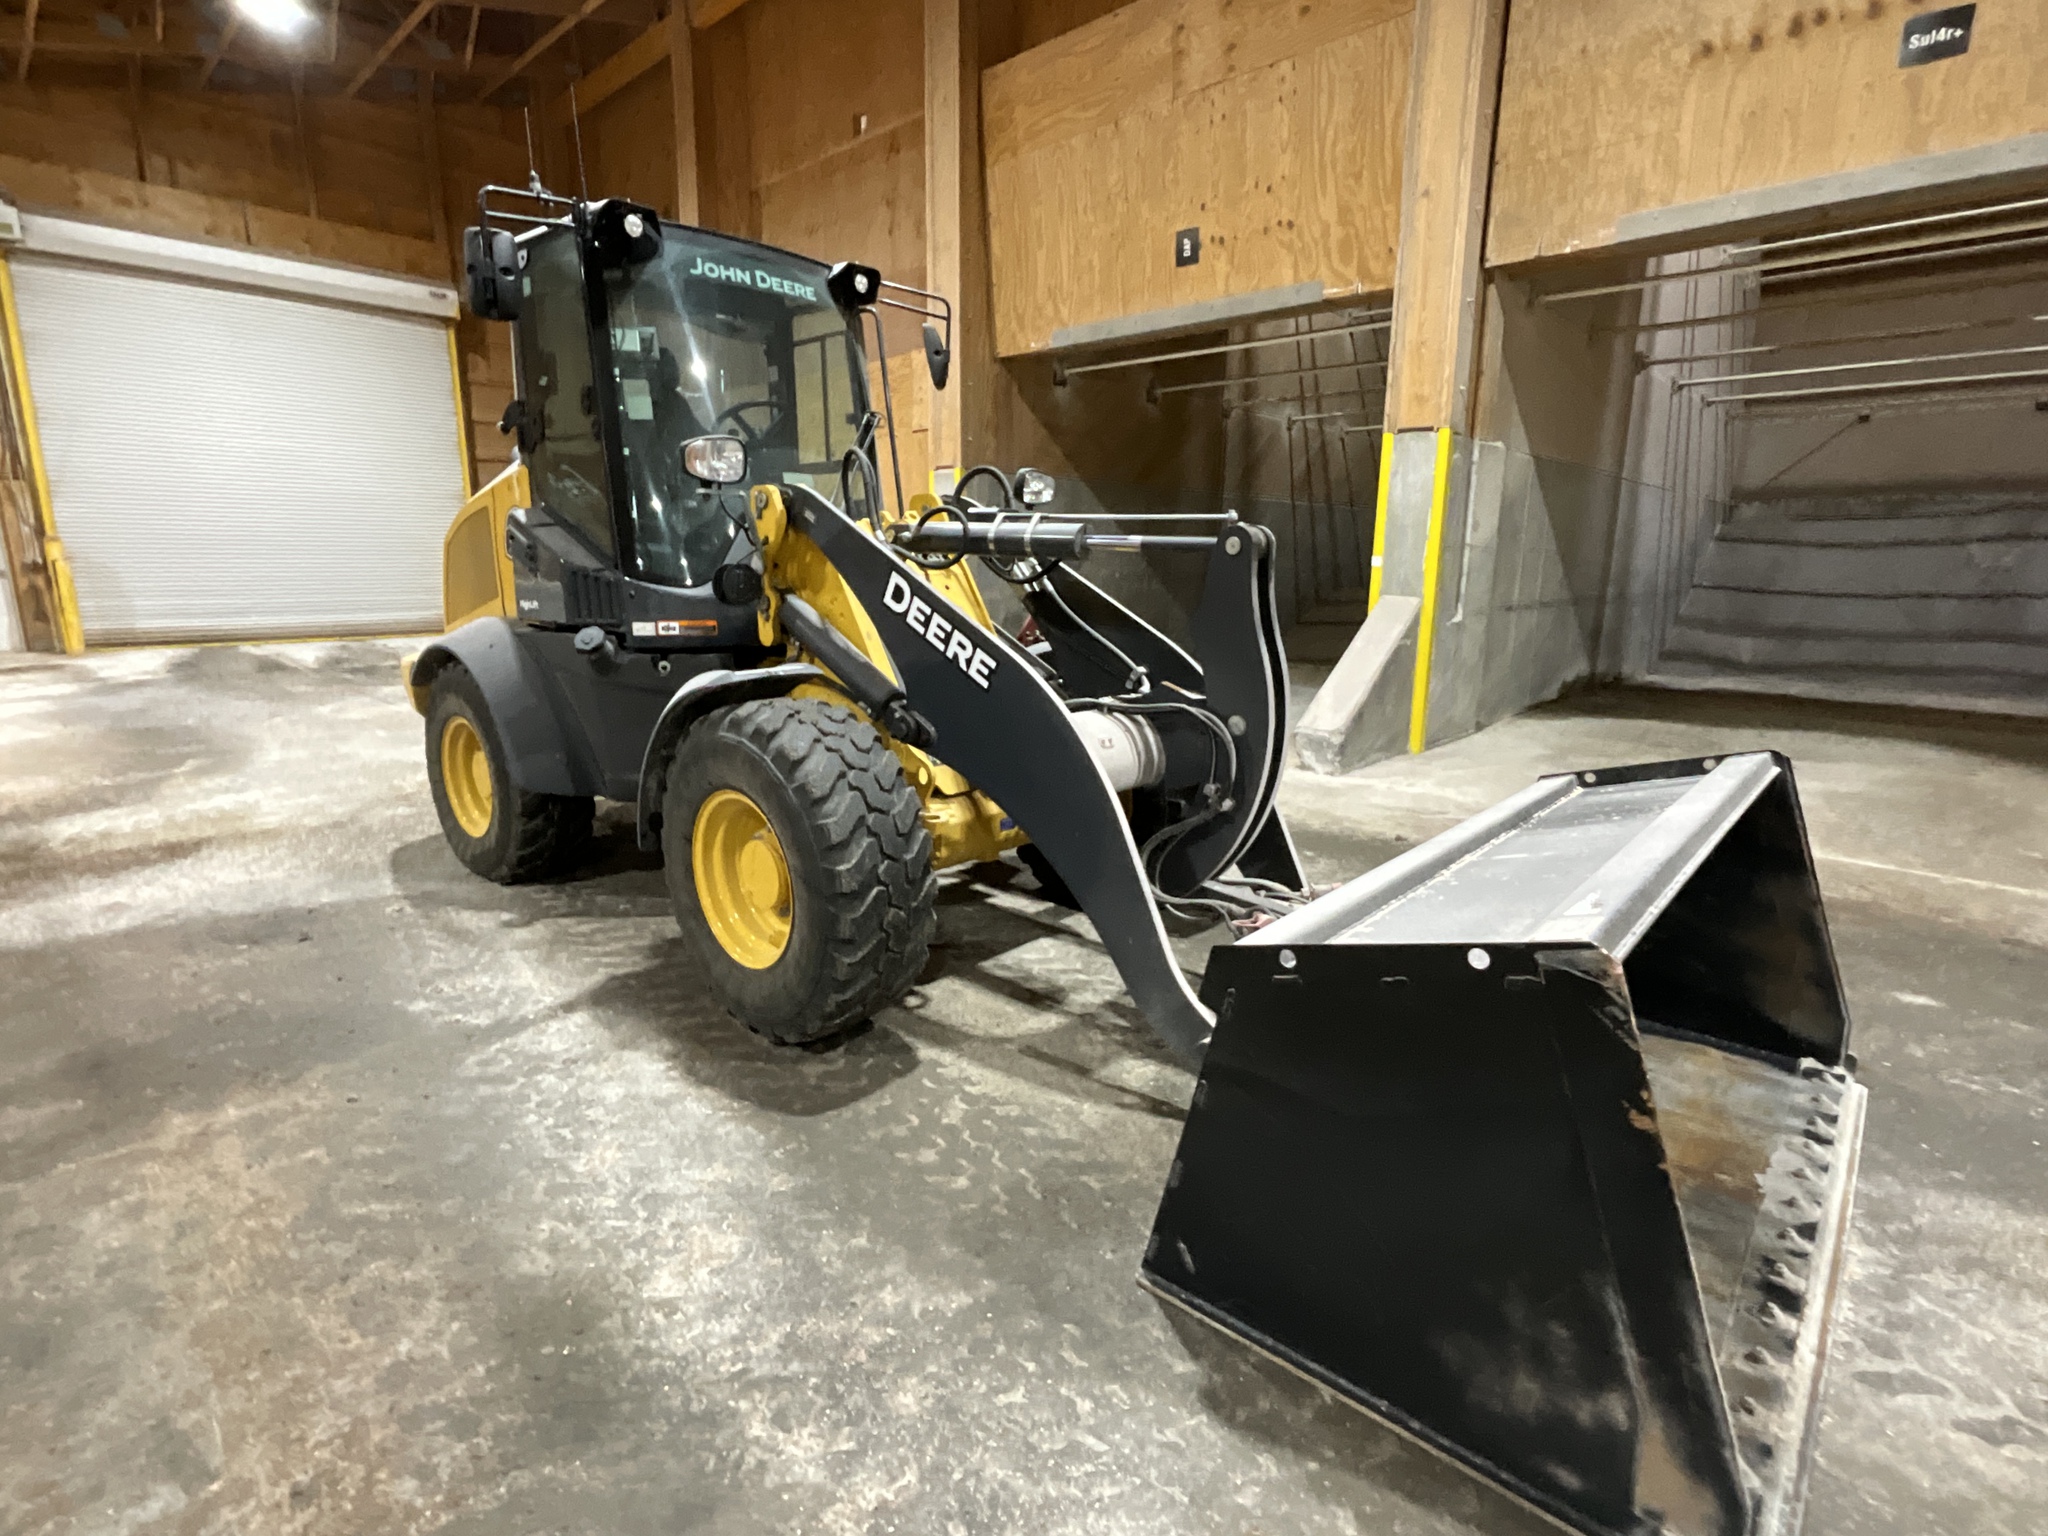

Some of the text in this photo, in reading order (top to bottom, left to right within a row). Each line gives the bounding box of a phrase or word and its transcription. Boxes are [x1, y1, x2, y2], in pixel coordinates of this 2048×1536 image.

[1183, 237, 1191, 257] DAP
[689, 257, 817, 302] JOHN DEERE
[882, 570, 998, 690] DEERE
